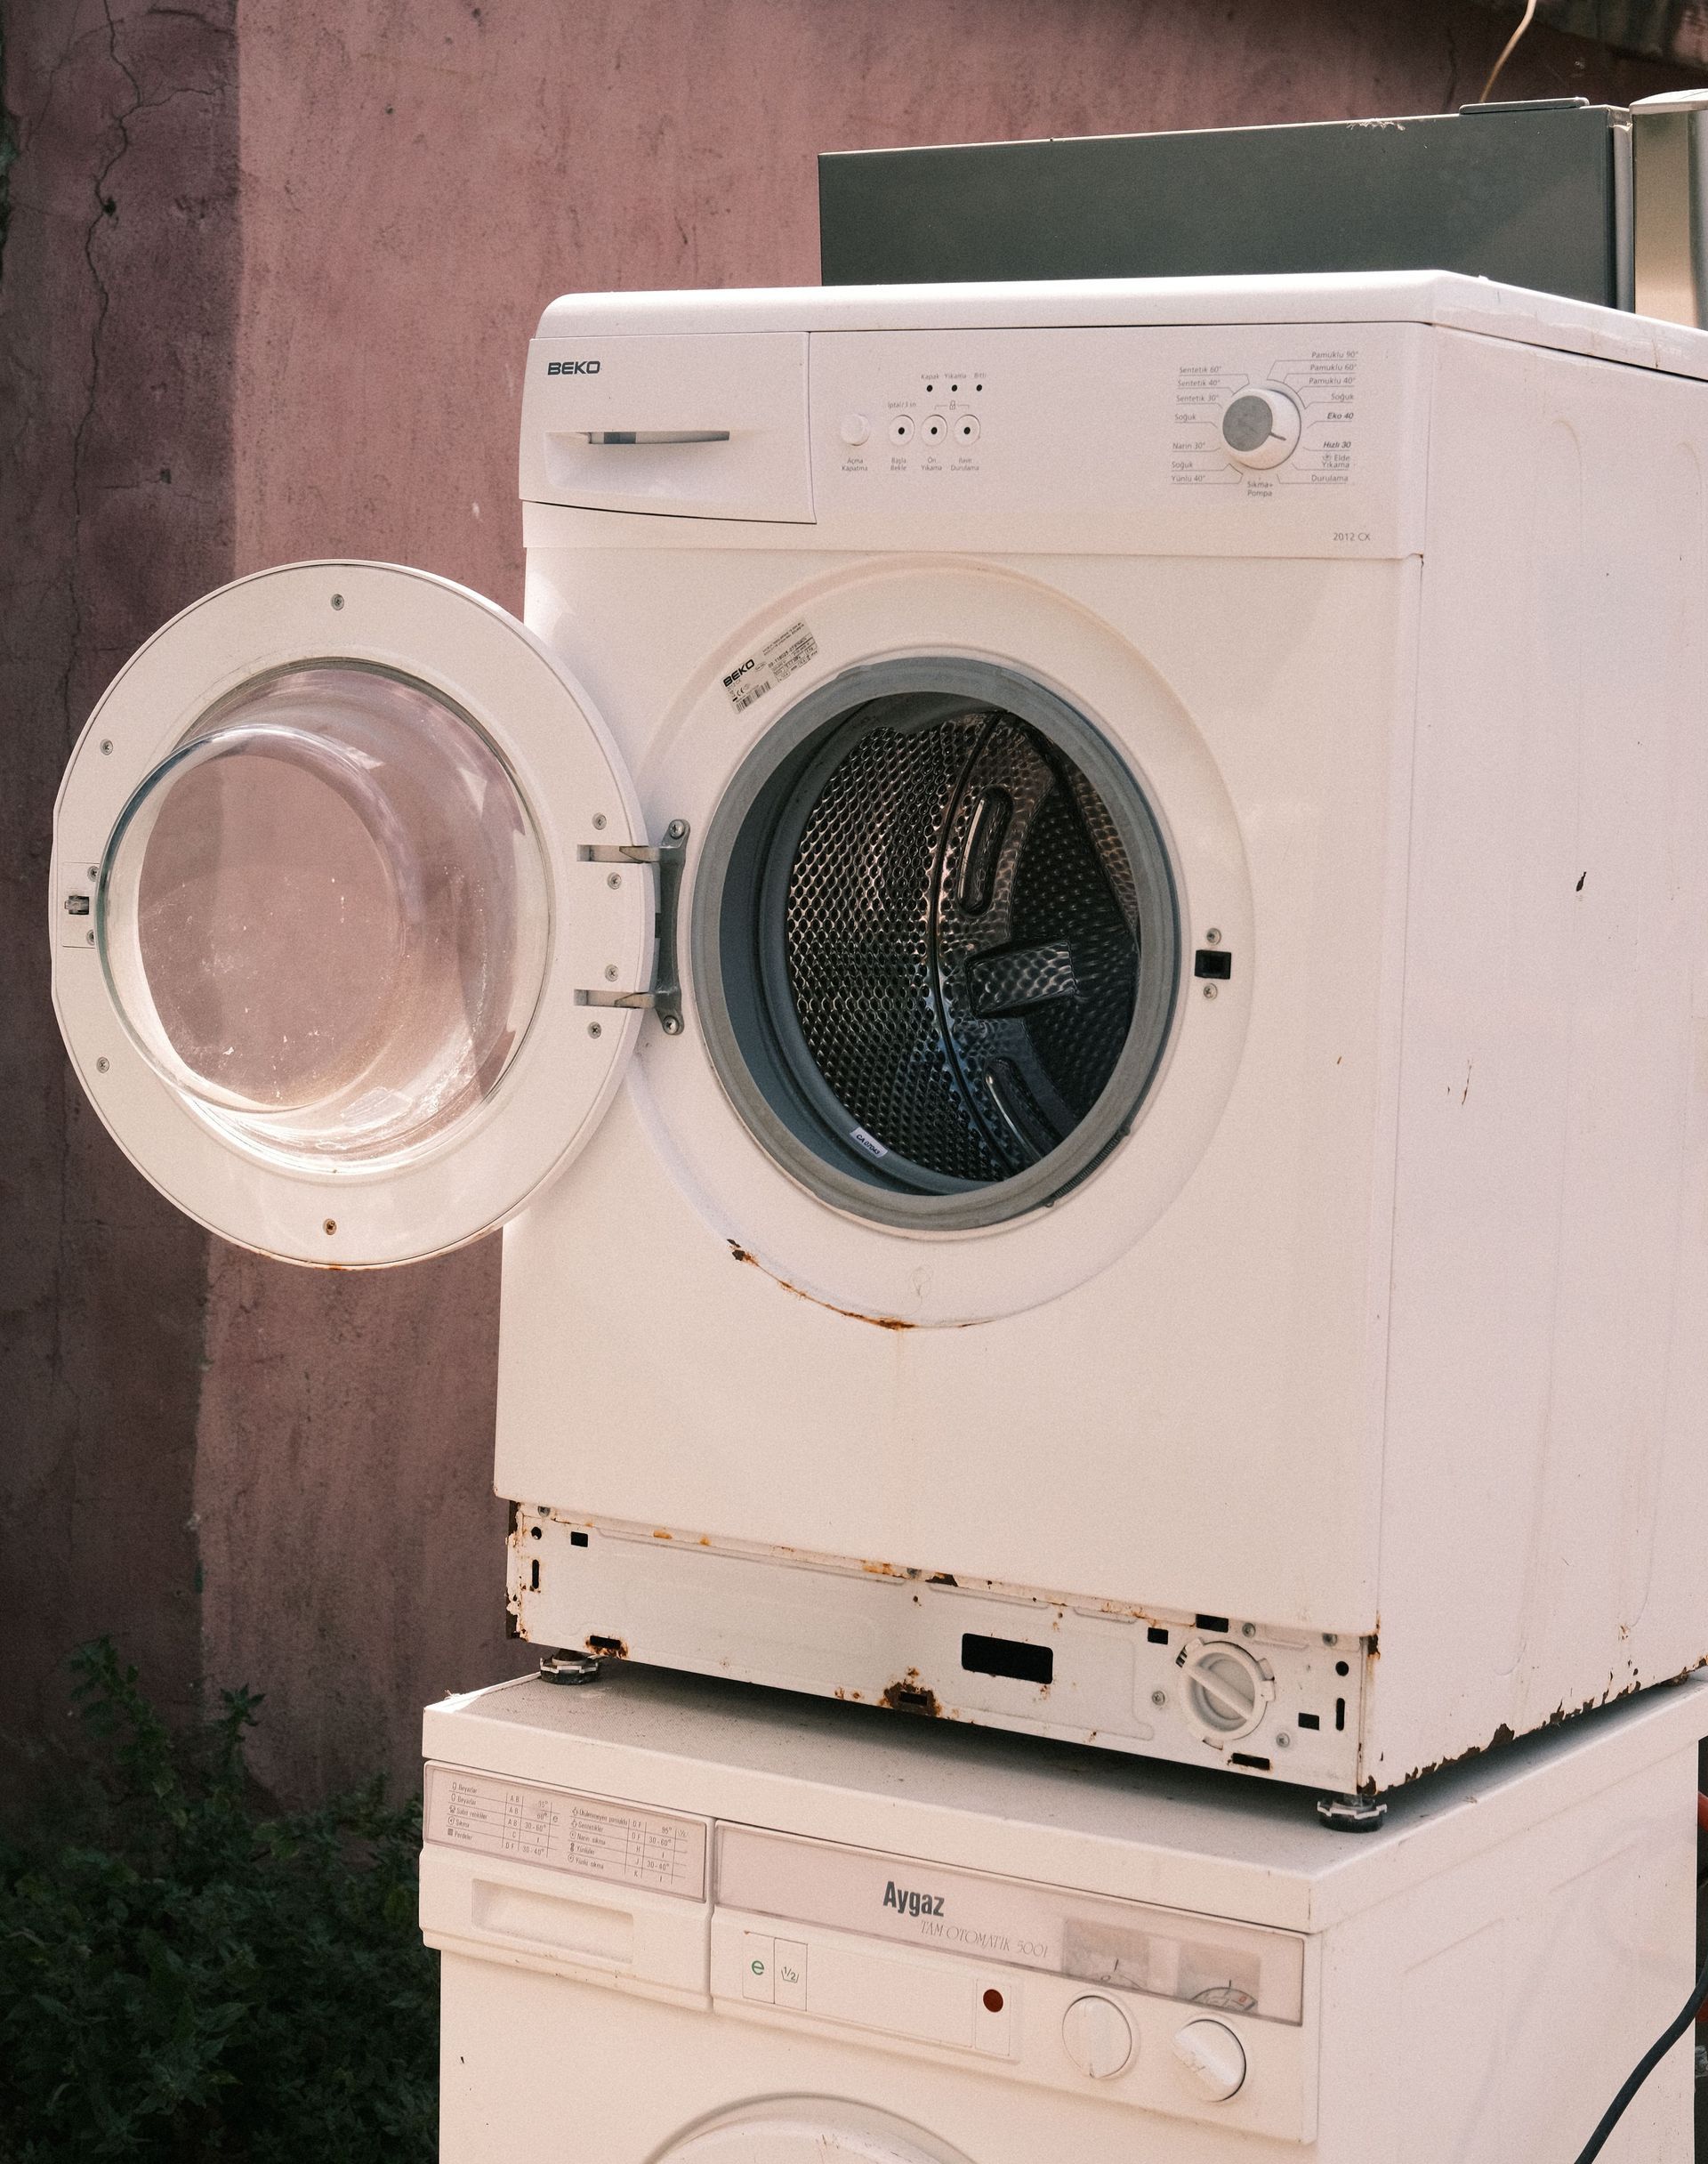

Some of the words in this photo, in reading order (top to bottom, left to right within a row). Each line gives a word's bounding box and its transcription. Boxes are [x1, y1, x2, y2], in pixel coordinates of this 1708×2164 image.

[1311, 351, 1343, 359] Pamuklu
[548, 361, 601, 375] BEKO
[1309, 364, 1342, 372] Pamuklu
[1178, 379, 1206, 387] Sentetik
[1309, 377, 1341, 385] Pamuklu
[1334, 454, 1350, 462] Elde
[1333, 532, 1356, 542] 2012
[1358, 532, 1371, 542] CX
[722, 658, 755, 687] BEKO
[856, 1134, 865, 1144] CA
[882, 1880, 945, 1918] Aygaz
[920, 1919, 944, 1938] TAM
